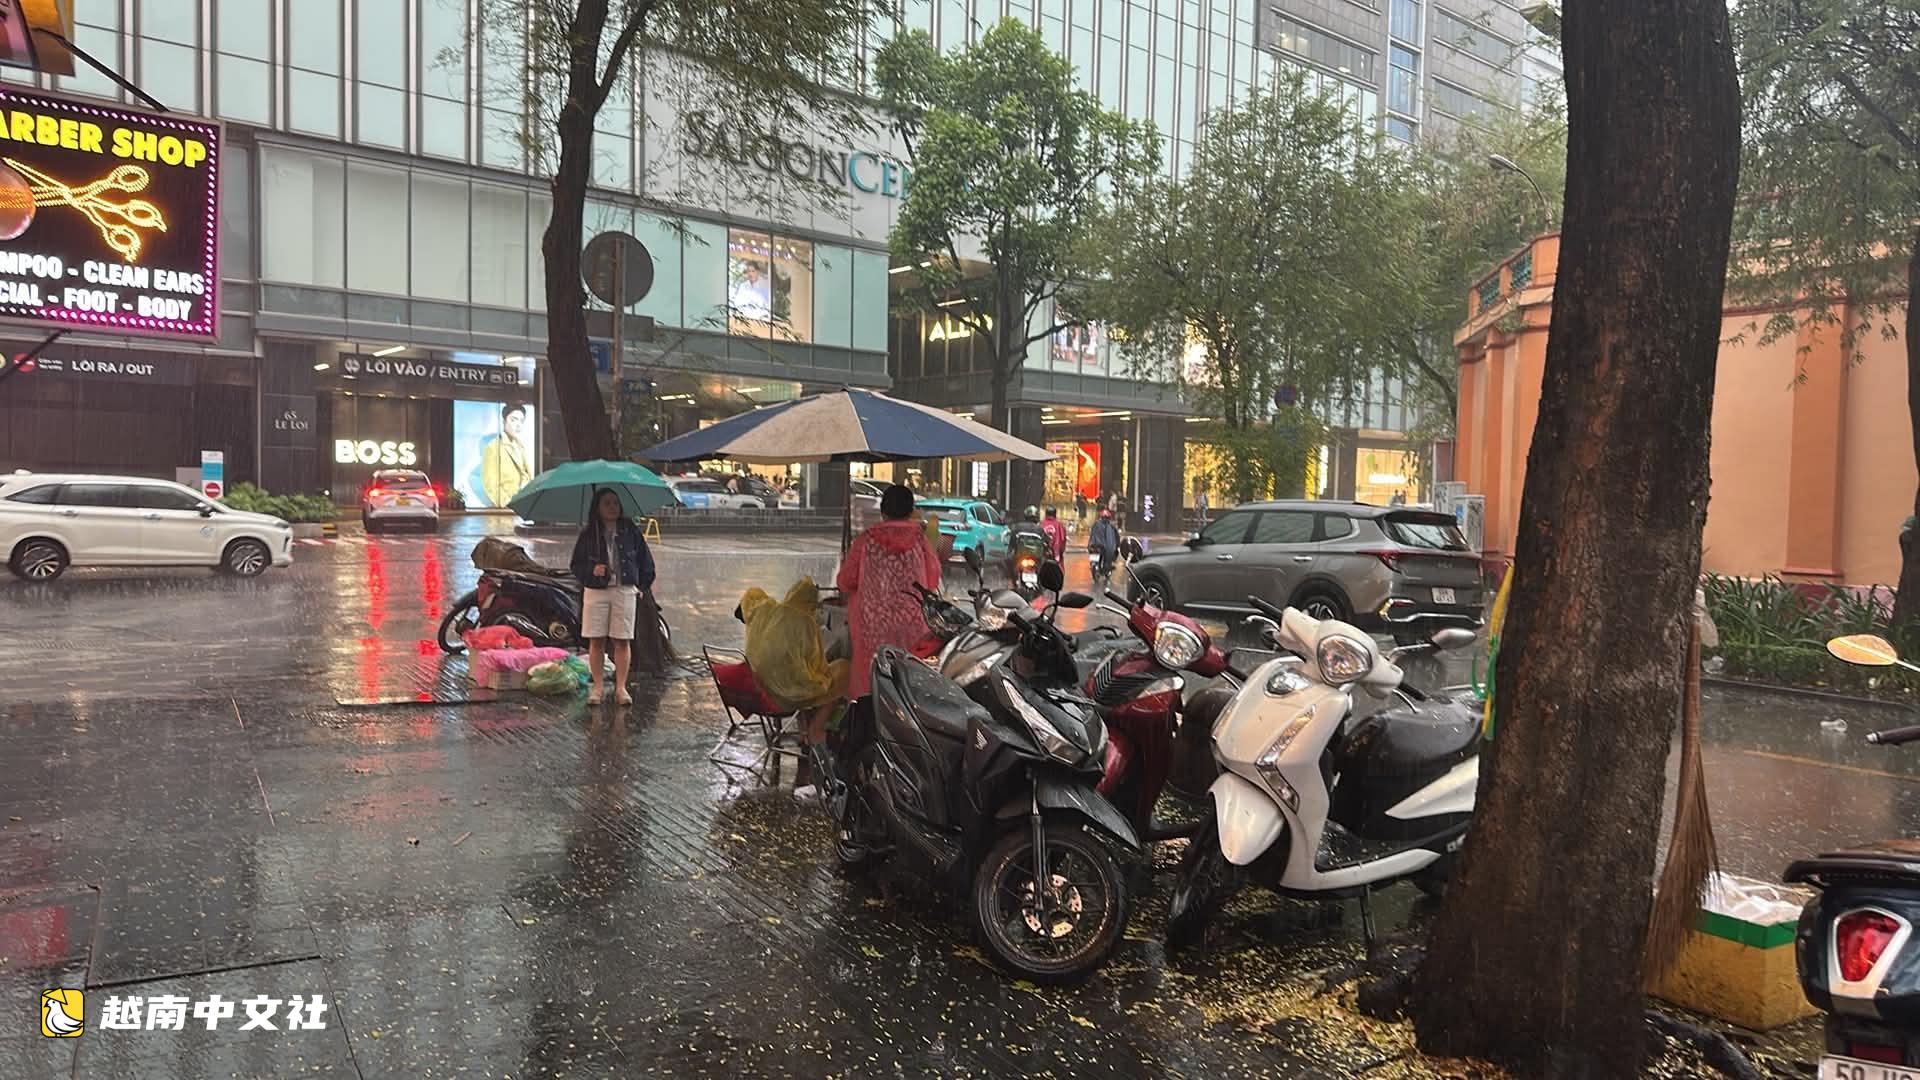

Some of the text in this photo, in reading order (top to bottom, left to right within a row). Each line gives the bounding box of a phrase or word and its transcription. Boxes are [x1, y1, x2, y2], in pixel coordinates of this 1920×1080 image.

[111, 128, 207, 168] SHOP
[83, 260, 149, 290] CLEAN
[153, 269, 205, 296] EARS
[64, 287, 119, 314] FOOT
[137, 295, 192, 321] BODY
[97, 362, 117, 373] RA
[126, 363, 154, 375] OUT
[439, 367, 487, 381] ENTRY
[335, 439, 417, 465] BOSS
